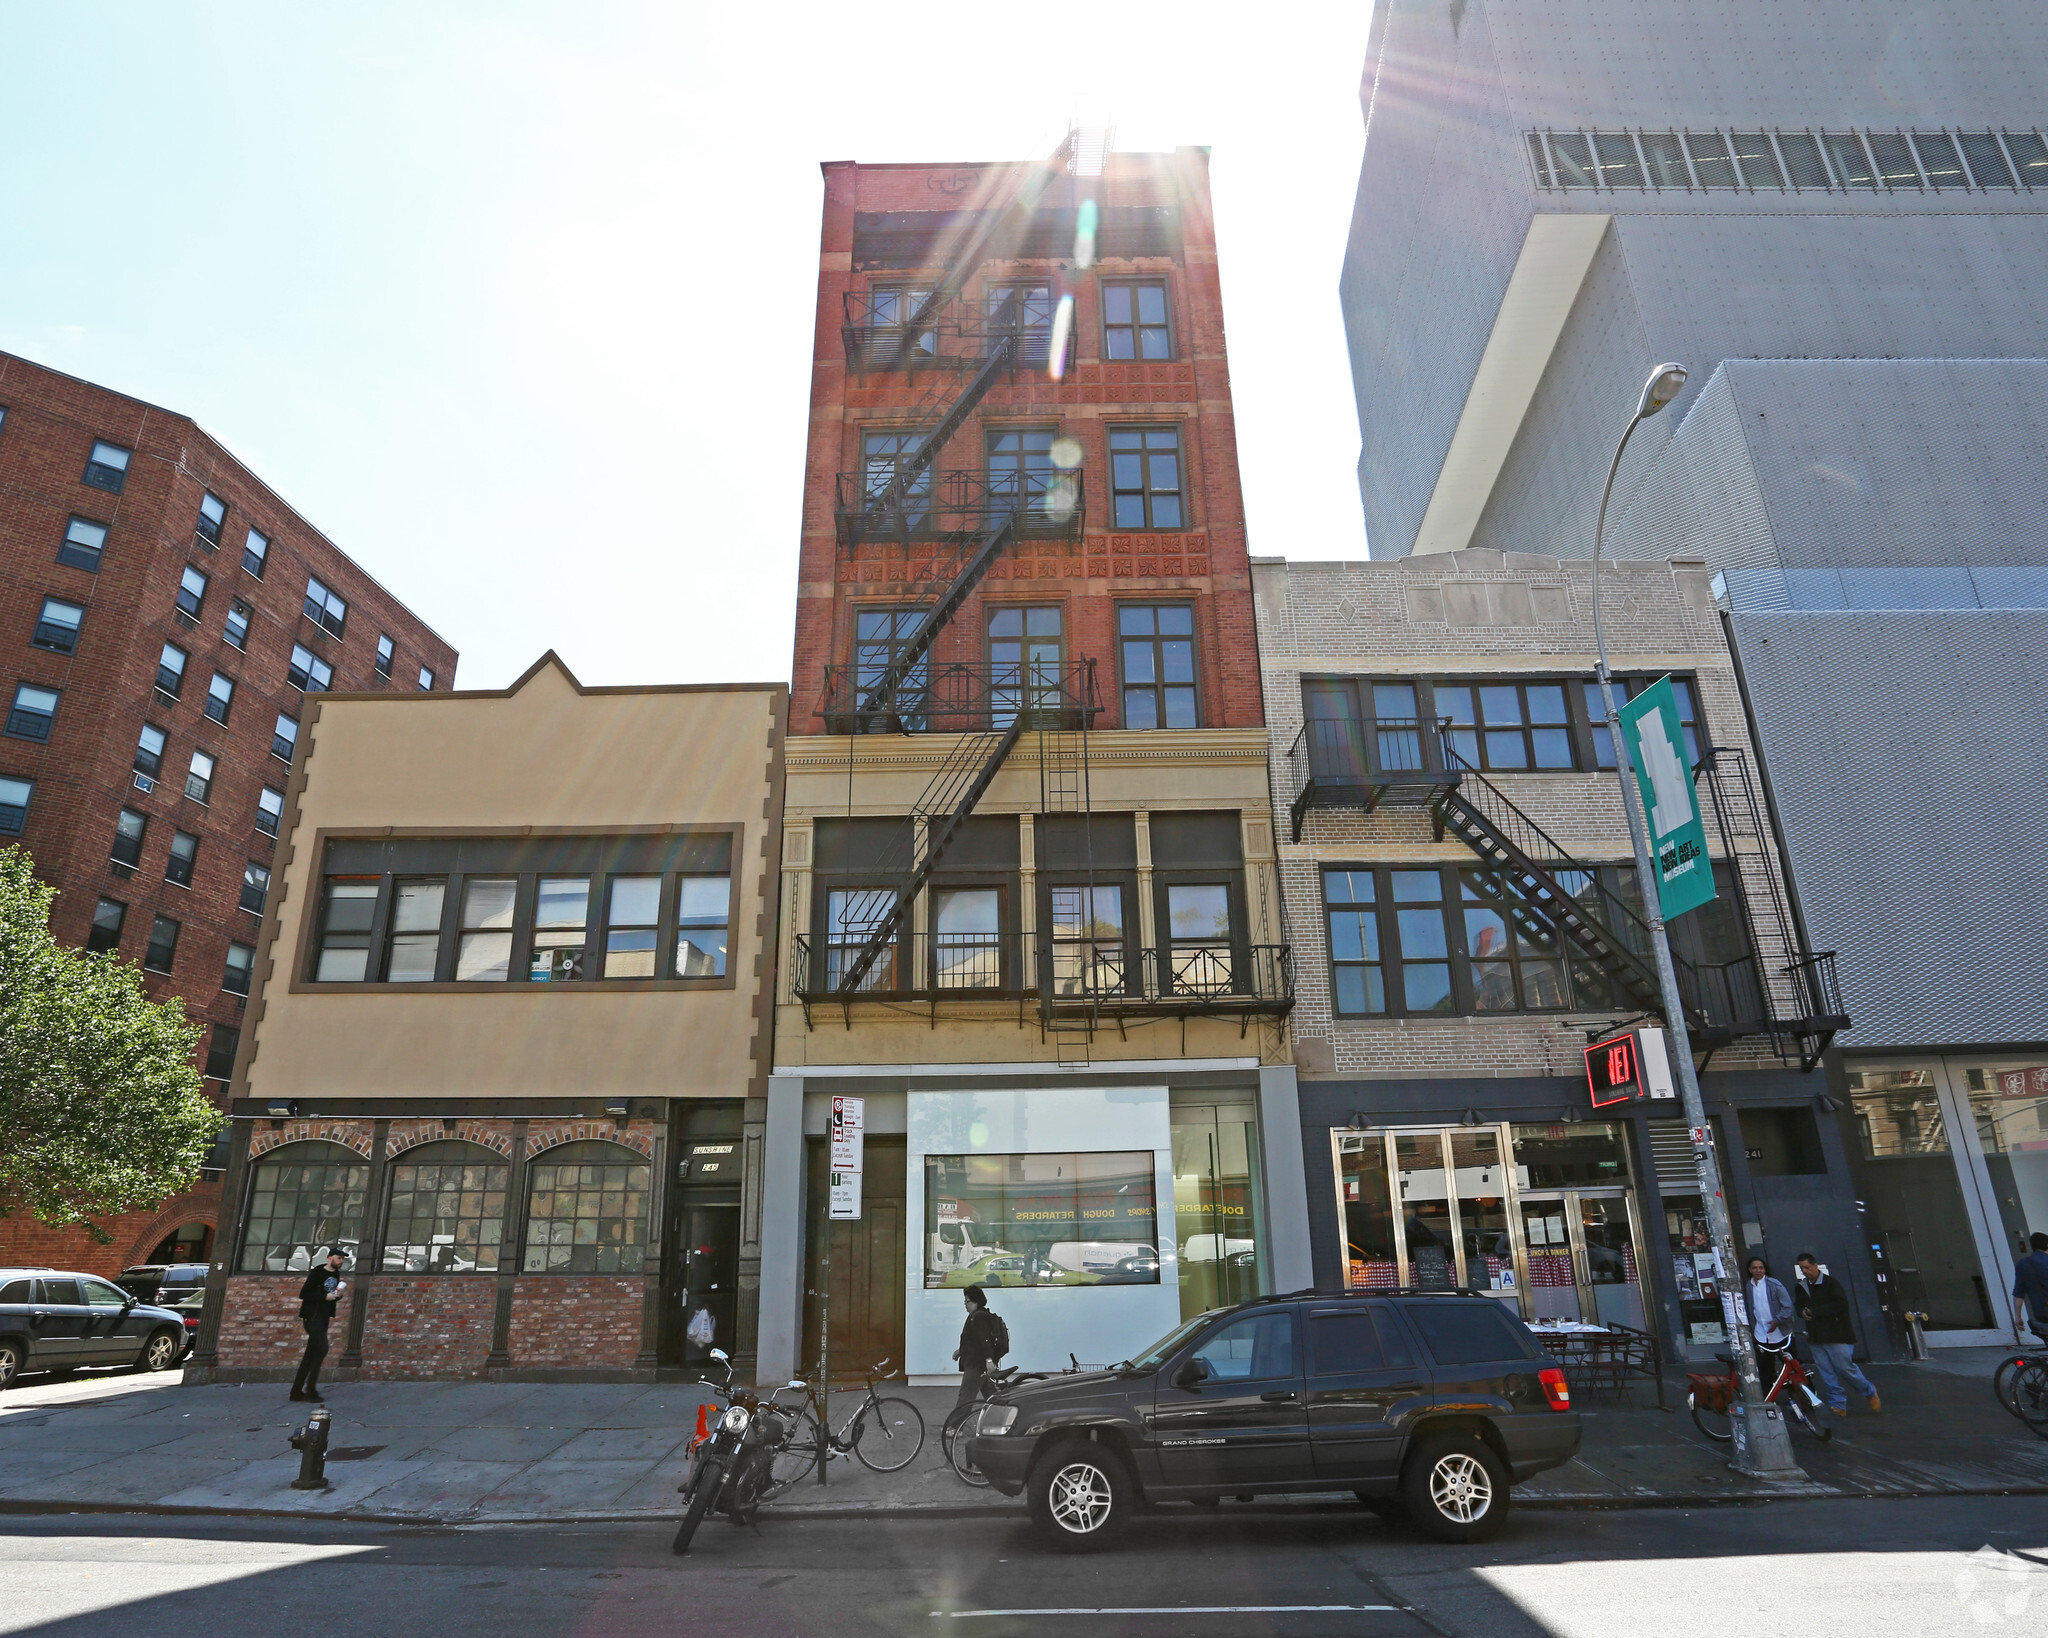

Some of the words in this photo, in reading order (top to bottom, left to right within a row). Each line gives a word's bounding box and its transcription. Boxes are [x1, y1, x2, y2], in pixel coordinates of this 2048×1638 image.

[1659, 840, 1674, 856] NEW
[1661, 849, 1676, 864] NEW
[1679, 840, 1692, 855] ART
[1662, 858, 1677, 873] NEW
[1680, 846, 1700, 864] IDEAS
[1664, 859, 1694, 882] MUSEUM
[1744, 1150, 1761, 1158] 241
[1503, 1272, 1513, 1284] A
